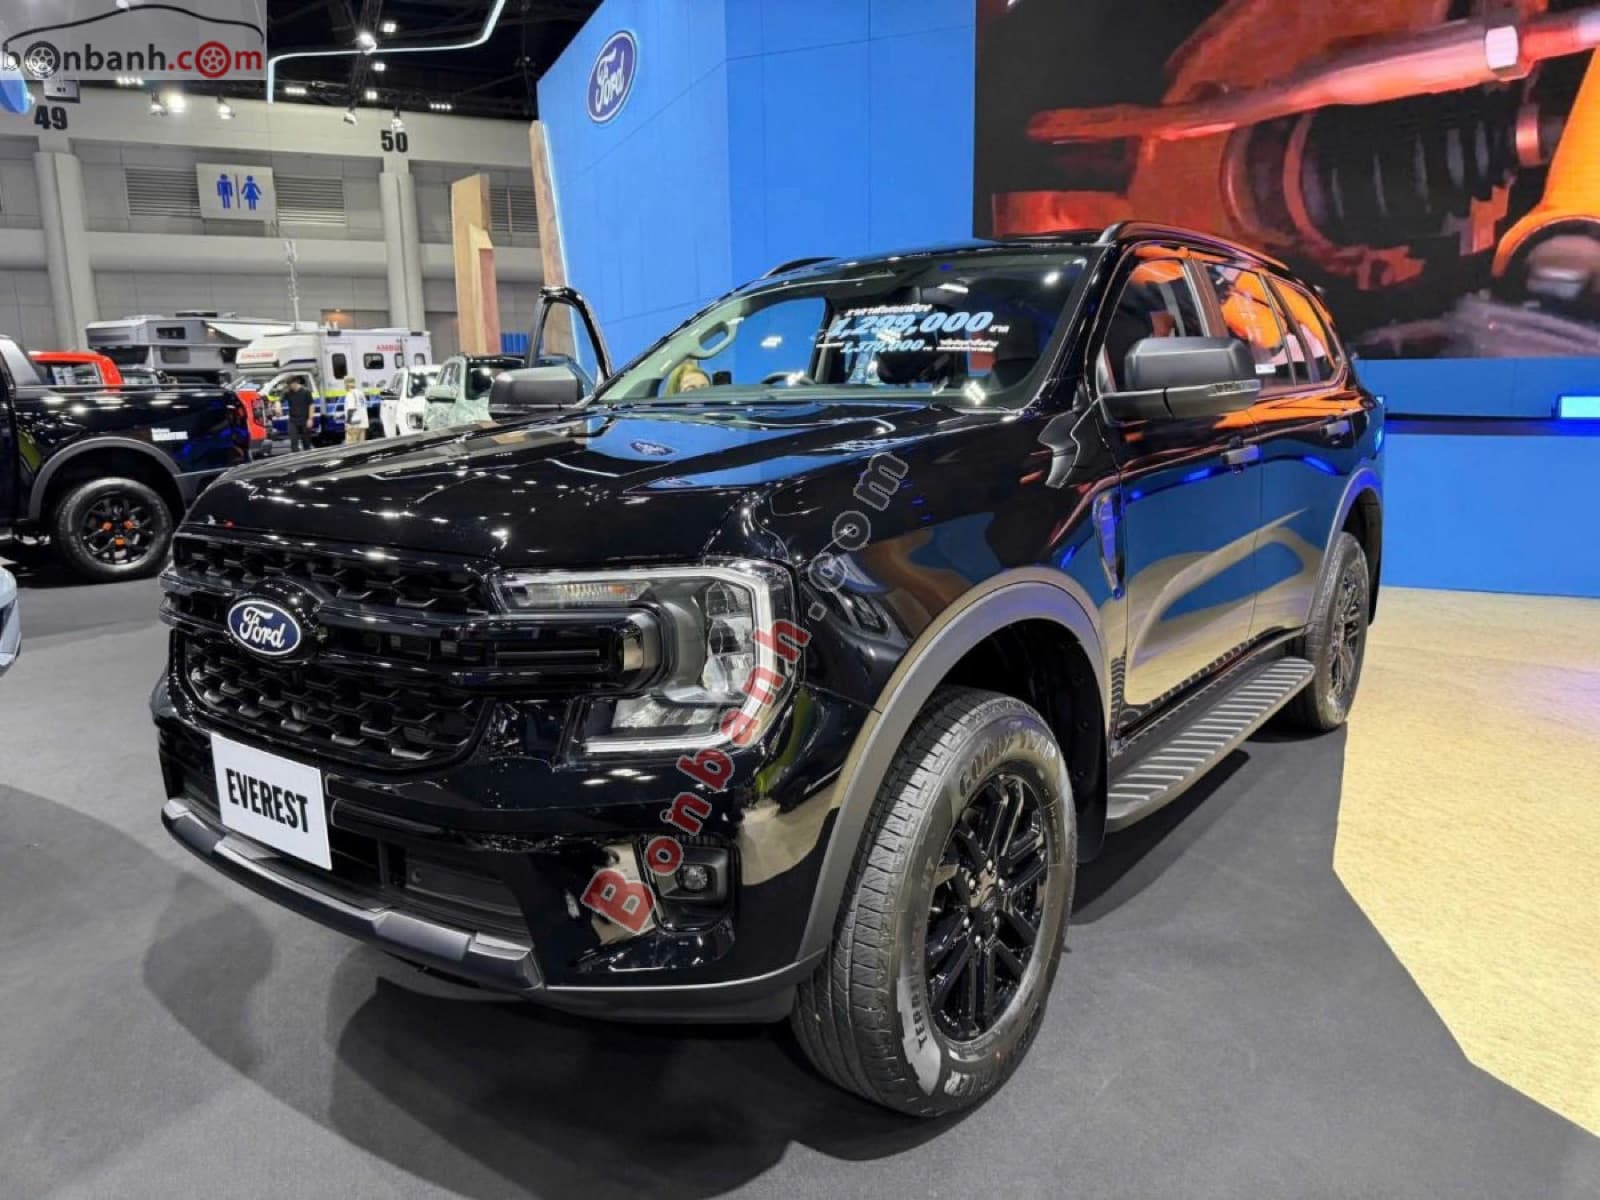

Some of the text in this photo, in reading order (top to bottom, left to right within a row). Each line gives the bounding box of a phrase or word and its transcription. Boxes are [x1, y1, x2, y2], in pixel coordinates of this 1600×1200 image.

[595, 47, 626, 112] Ford
[34, 105, 68, 130] 49
[380, 130, 408, 153] 50
[239, 605, 286, 649] Ford
[225, 767, 309, 834] EVEREST
